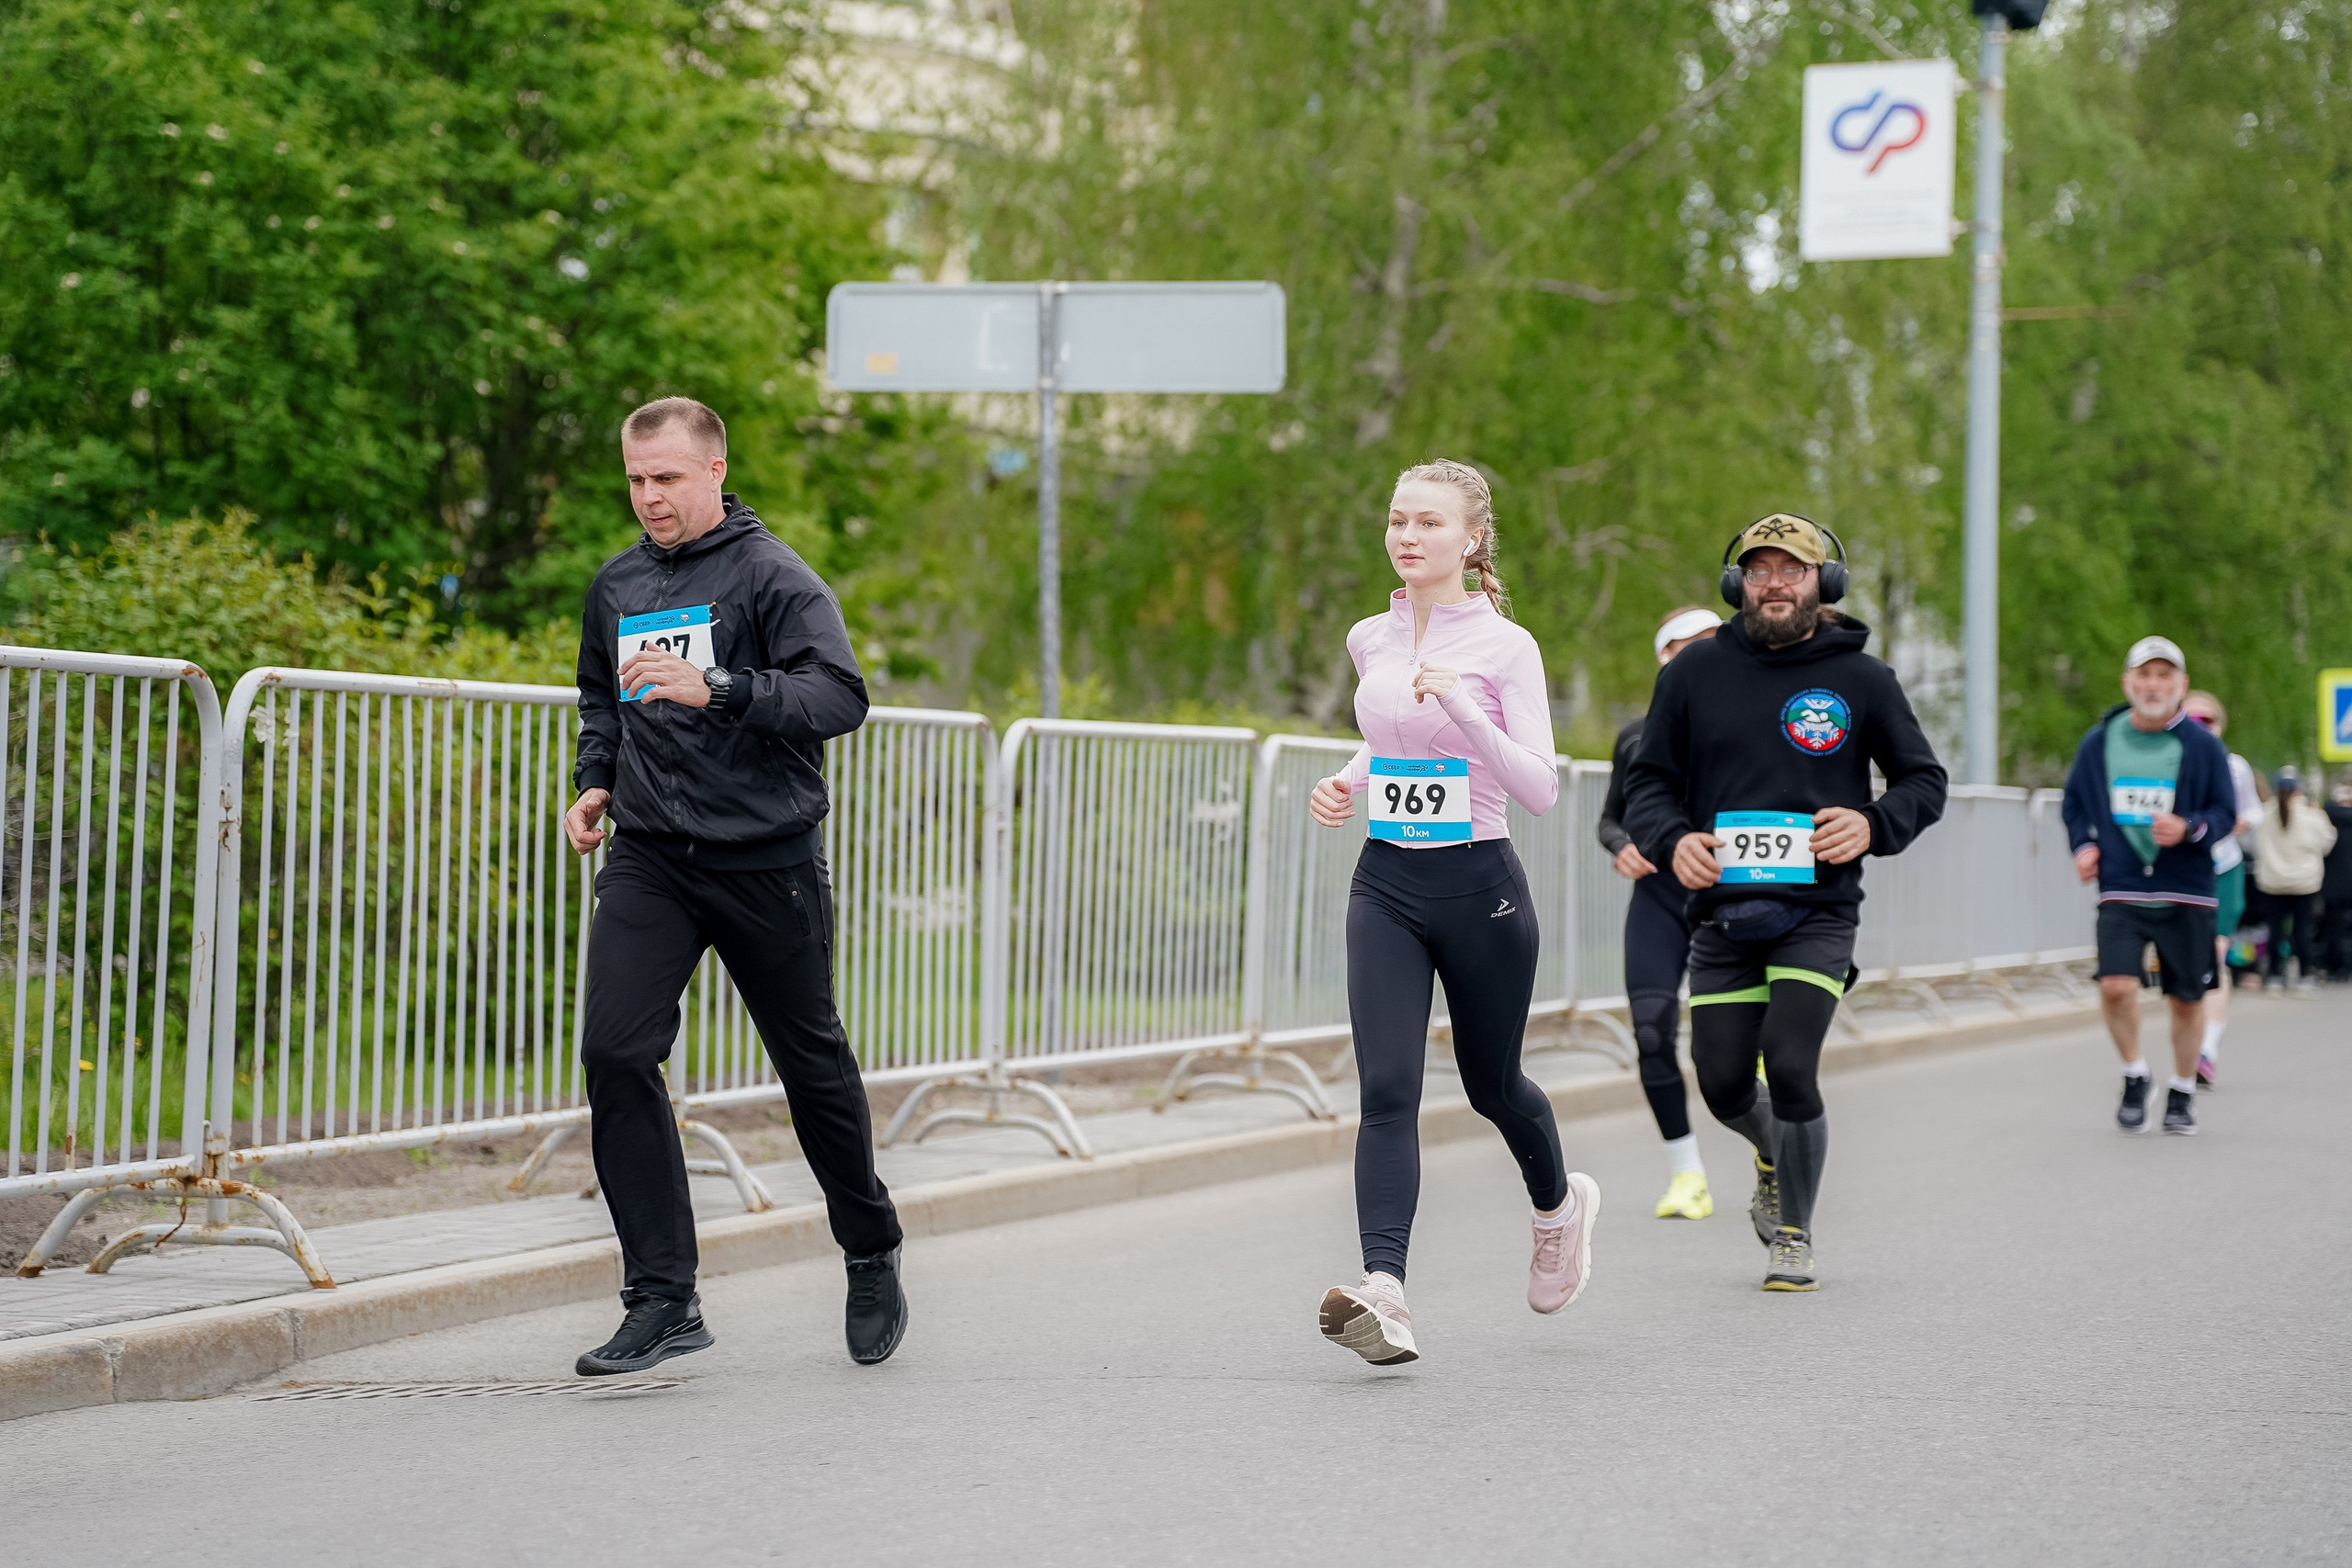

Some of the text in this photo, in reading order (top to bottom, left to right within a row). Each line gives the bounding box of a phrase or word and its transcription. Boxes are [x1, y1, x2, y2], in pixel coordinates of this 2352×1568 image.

[1385, 783, 1446, 815] 969
[1735, 833, 1793, 860] 959
[1490, 906, 1516, 918] DEMIX
